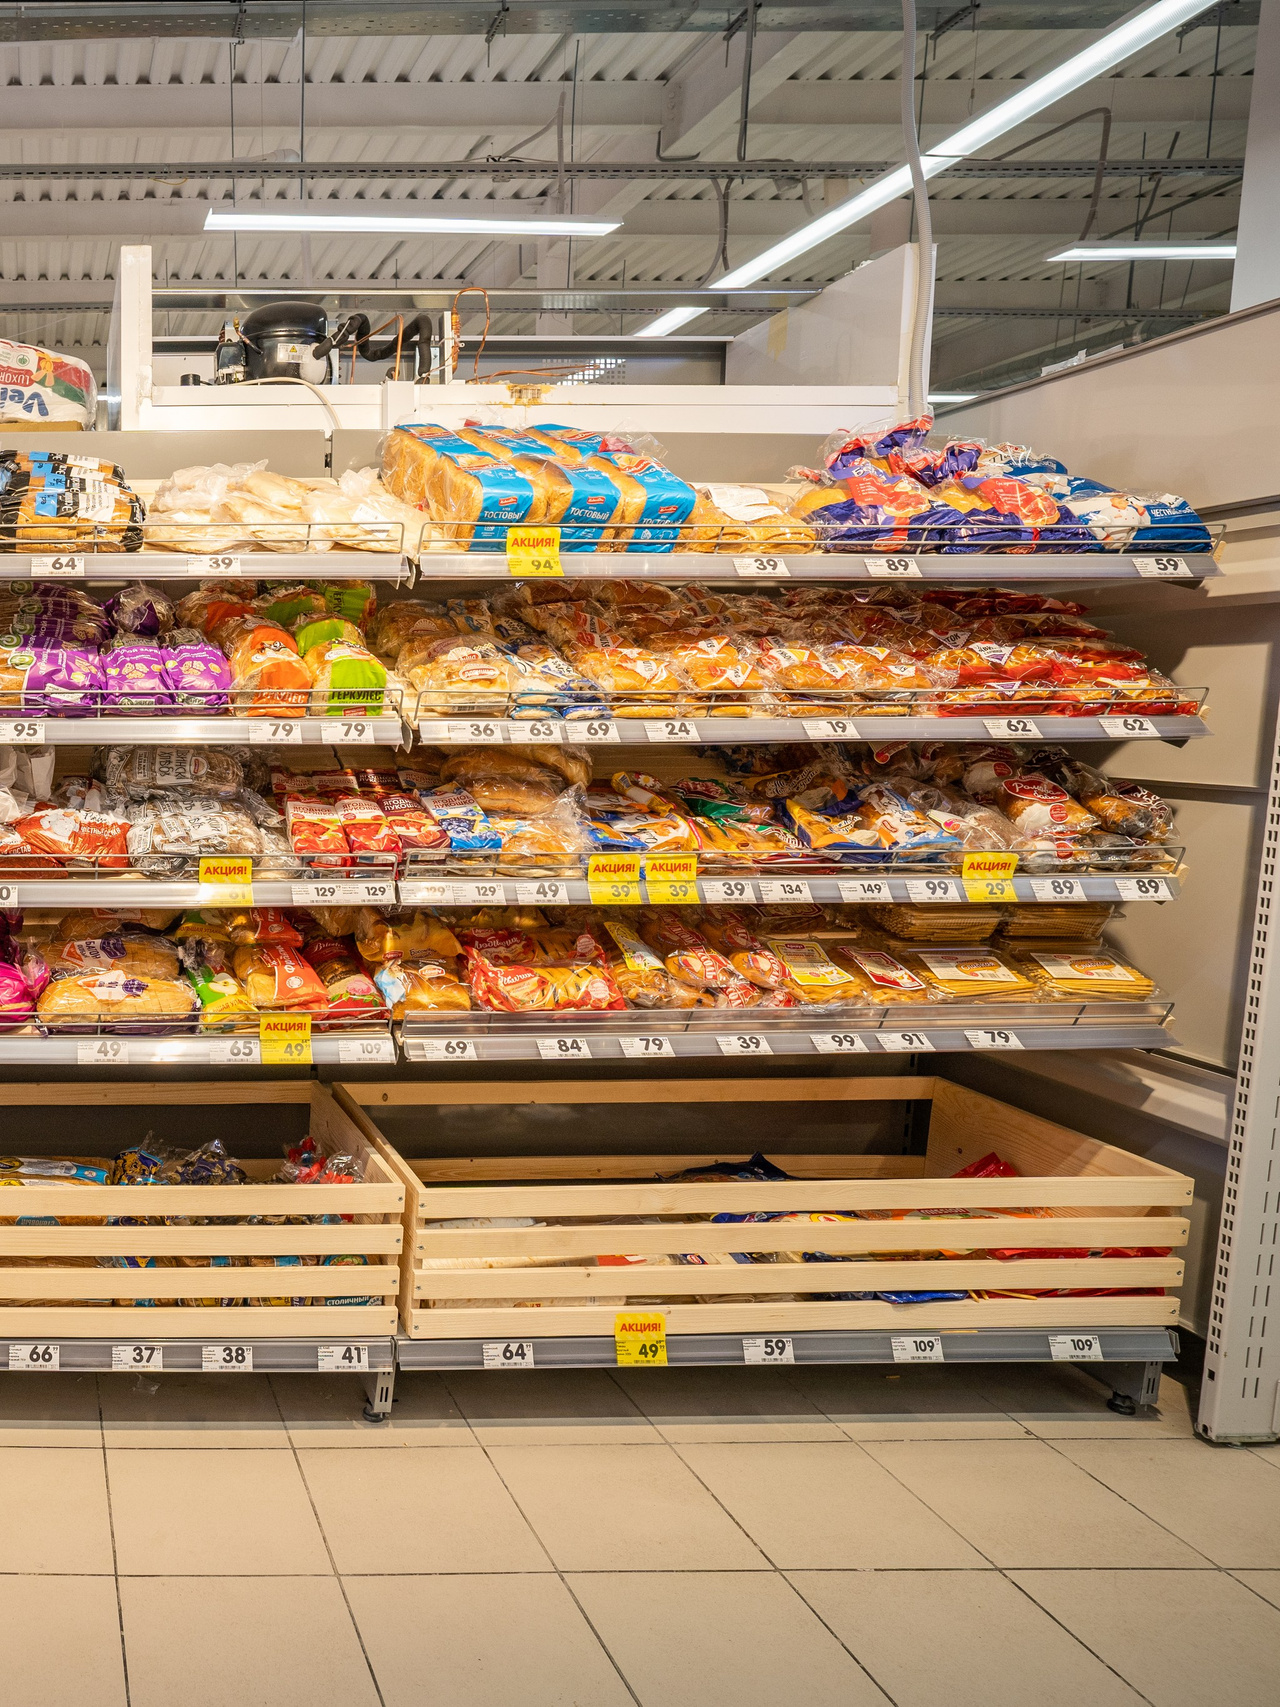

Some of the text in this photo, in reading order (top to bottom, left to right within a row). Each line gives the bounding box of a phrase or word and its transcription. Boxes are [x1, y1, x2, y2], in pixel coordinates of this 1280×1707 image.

[570, 506, 610, 520] ТОСТОВЫЙ
[511, 537, 555, 547] АКЦИЯ!
[51, 557, 77, 570] 64
[208, 556, 233, 570] 39
[531, 559, 554, 571] 94
[753, 558, 778, 571] 39
[886, 559, 909, 572] 89
[1154, 558, 1179, 571] 59
[331, 690, 382, 701] ГЕРКУЛЕС
[13, 723, 38, 737] 95
[268, 723, 294, 737] 79
[340, 723, 365, 737] 79
[470, 723, 495, 736] 36
[529, 722, 554, 736] 63
[586, 722, 610, 736] 69
[664, 722, 691, 736] 24
[827, 720, 847, 734] 19
[1006, 719, 1032, 733] 62
[1122, 719, 1149, 732] 62
[1011, 782, 1063, 797] Ромовая
[292, 805, 330, 813] ЯГОДНОЕ
[434, 799, 476, 809] ЛУКОШКО
[292, 810, 335, 818] ЛУКОШКО
[204, 864, 247, 876] АКЦИЯ!
[593, 862, 635, 873] АКЦИЯ!
[650, 861, 692, 872] АКЦИЯ!
[967, 860, 1011, 872] АКЦИЯ!
[314, 887, 336, 898] 129
[365, 886, 387, 897] 129
[474, 886, 497, 897] 129
[535, 882, 560, 898] 49
[610, 884, 631, 898] 39
[669, 884, 689, 898] 39
[721, 881, 745, 896] 39
[780, 884, 803, 895] 134
[860, 883, 883, 894] 149
[924, 880, 949, 895] 99
[985, 882, 1006, 896] 29
[1050, 879, 1075, 895] 89
[1135, 879, 1160, 894] 89
[265, 1021, 307, 1032] АКЦИЯ!
[638, 1037, 664, 1051] 79
[735, 1035, 761, 1049] 39
[831, 1034, 856, 1048] 99
[900, 1033, 925, 1046] 91
[983, 1030, 1011, 1044] 79
[96, 1041, 121, 1057] 49
[229, 1041, 254, 1057] 65
[283, 1043, 304, 1057] 49
[359, 1043, 382, 1054] 109
[444, 1041, 467, 1055] 69
[557, 1039, 583, 1053] 84
[325, 1295, 370, 1307] СТОЛИЧНЫЙ
[620, 1322, 661, 1333] АКЦИЯ!
[501, 1343, 527, 1361] 64
[638, 1343, 659, 1359] 49
[764, 1339, 786, 1356] 59
[912, 1339, 935, 1353] 109
[1070, 1338, 1094, 1352] 109
[28, 1345, 53, 1363] 66
[132, 1346, 156, 1364] 37
[222, 1346, 246, 1364] 38
[341, 1347, 364, 1364] 41
